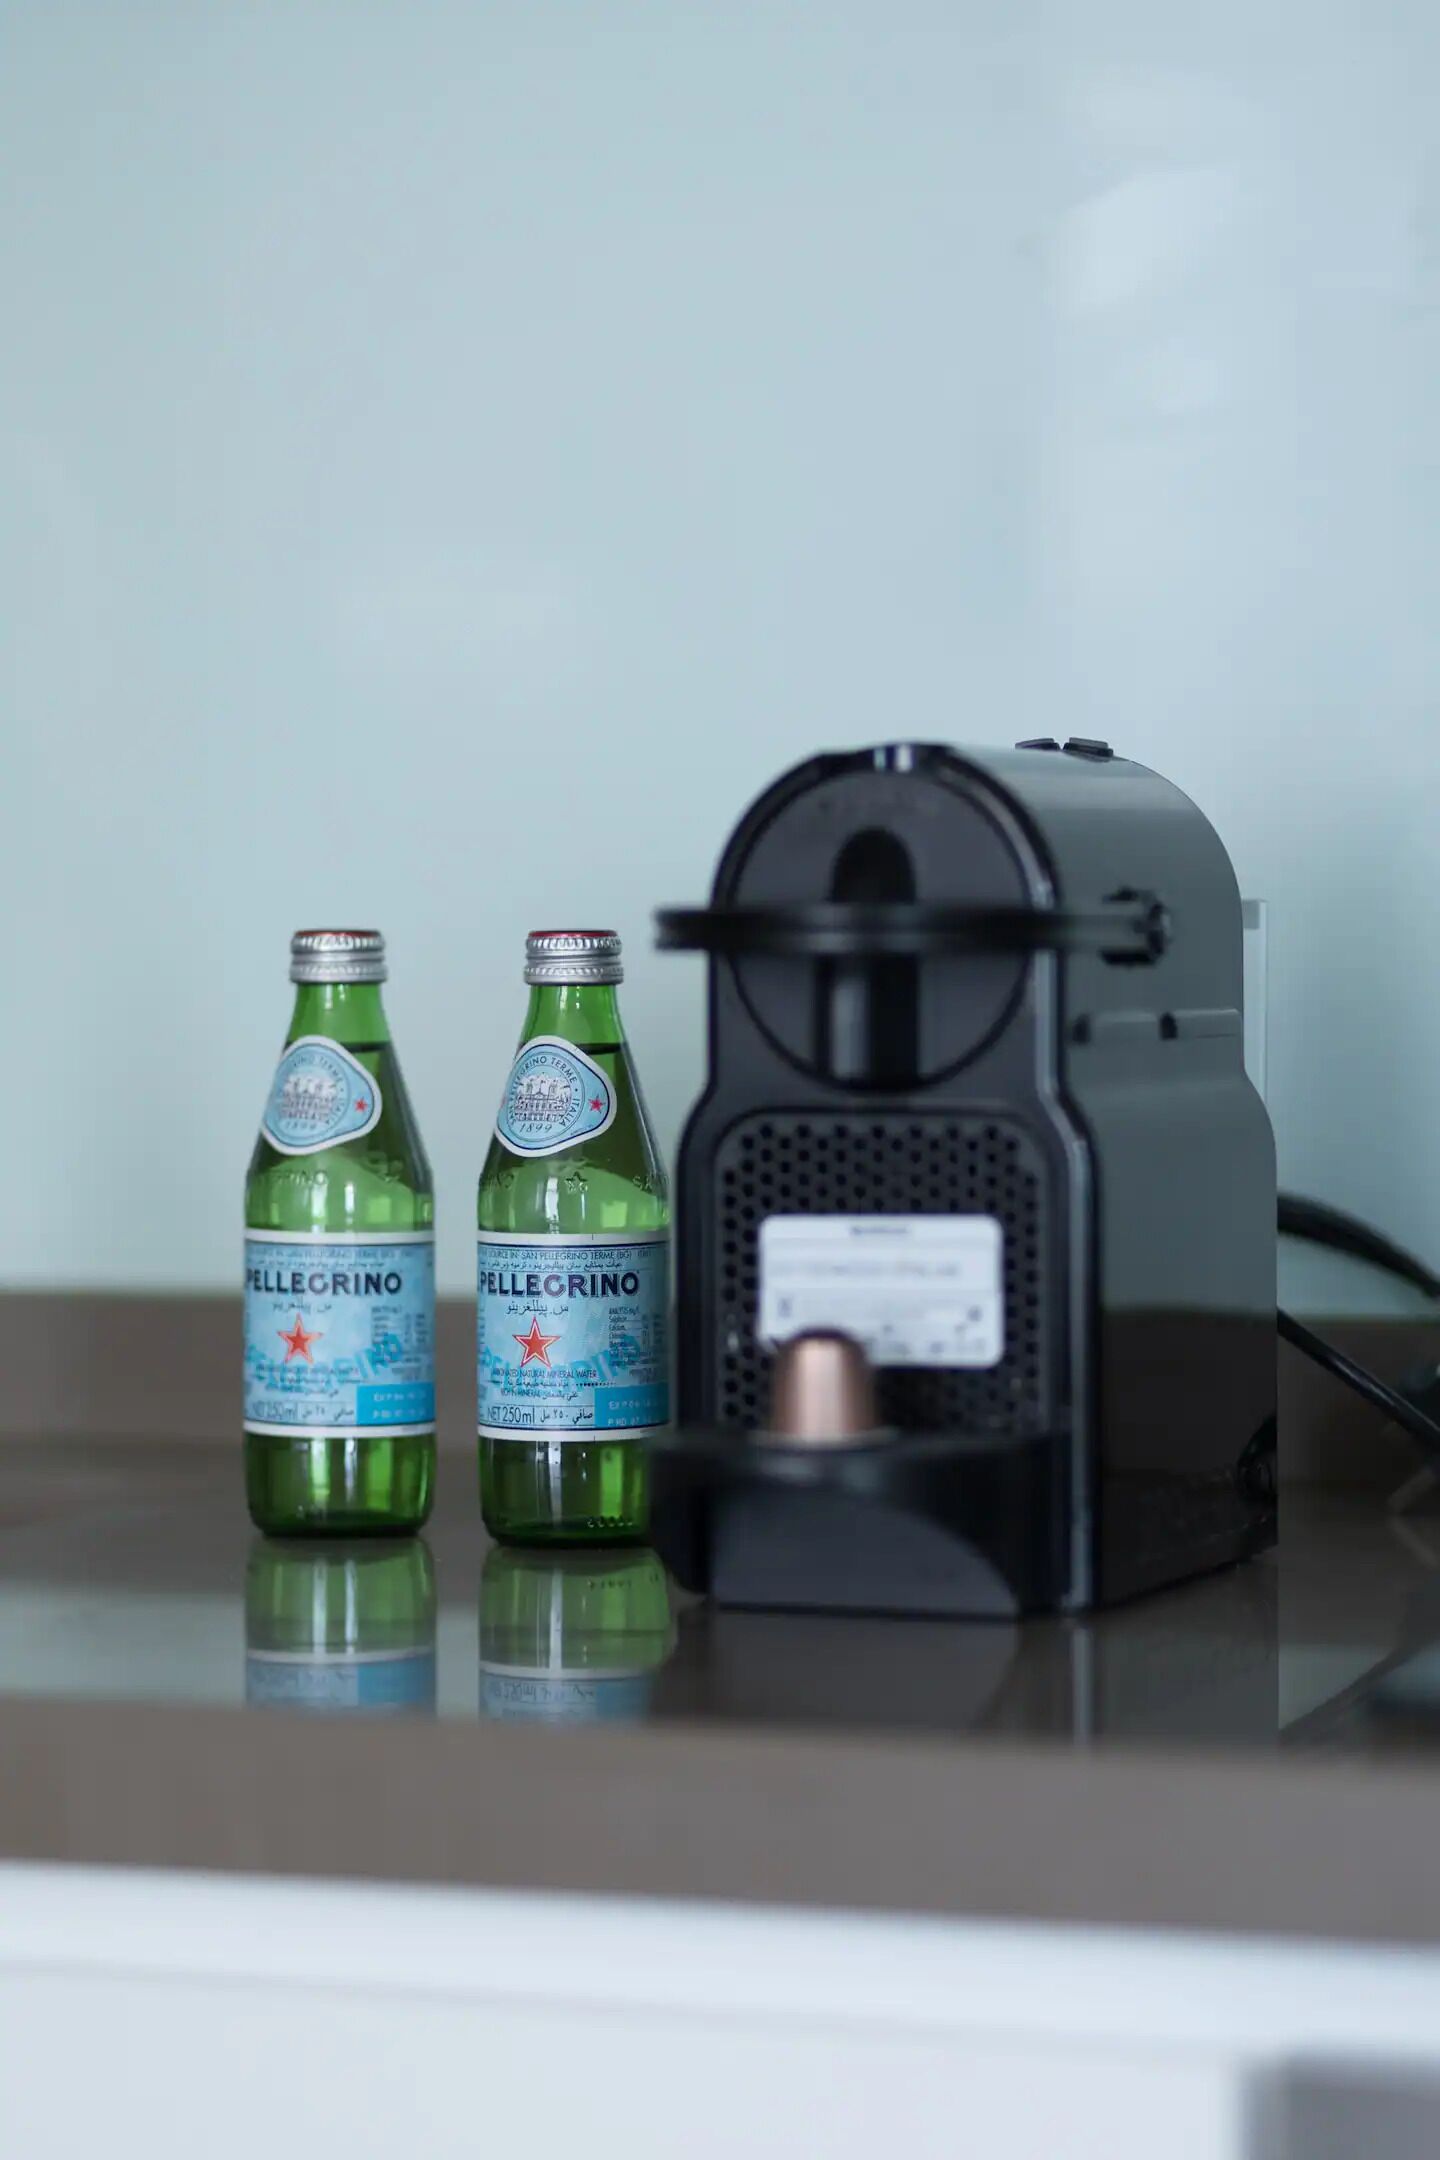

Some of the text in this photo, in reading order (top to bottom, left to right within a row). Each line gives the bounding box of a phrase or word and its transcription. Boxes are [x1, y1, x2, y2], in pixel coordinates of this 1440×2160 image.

[551, 1056, 578, 1083] TERME
[559, 1098, 580, 1127] ITALIA
[519, 1122, 553, 1134] 1899
[521, 1250, 538, 1261] SAN
[539, 1251, 588, 1261] PELLEGRINO
[590, 1250, 615, 1260] TERME
[247, 1267, 402, 1296] PELLEGRINO
[480, 1270, 639, 1298] PELLEGRINO
[575, 1368, 598, 1379] WATER
[488, 1406, 536, 1424] NET 250ml
[540, 1407, 551, 1423] مل
[572, 1407, 594, 1425] صافي
